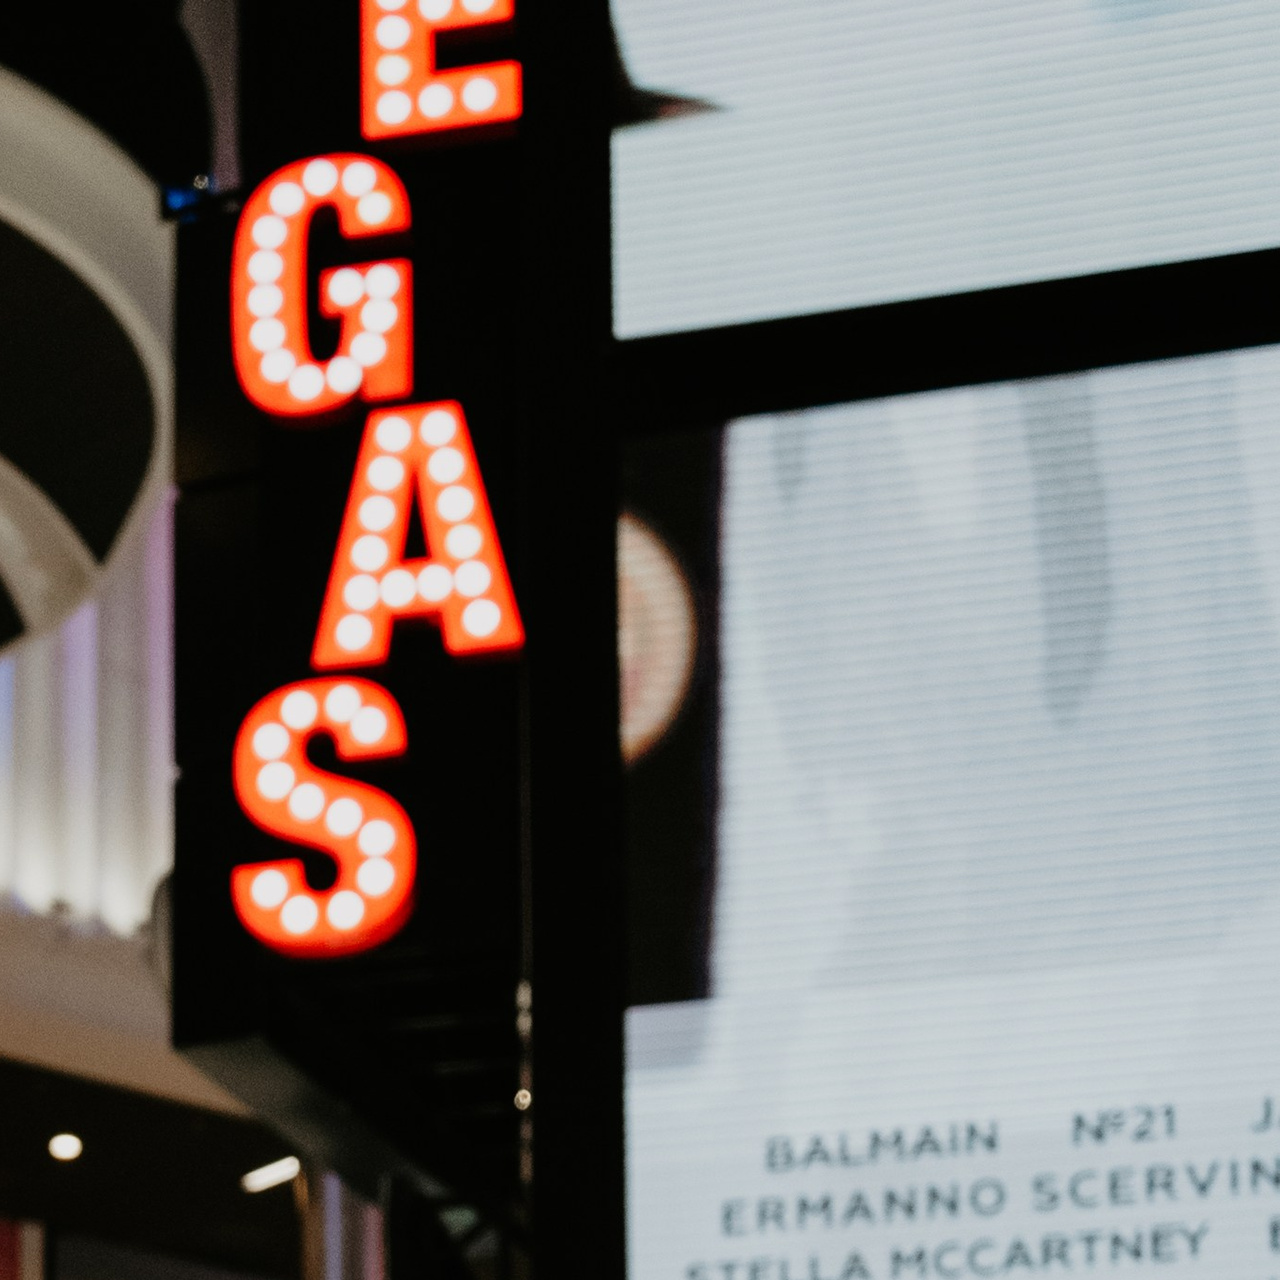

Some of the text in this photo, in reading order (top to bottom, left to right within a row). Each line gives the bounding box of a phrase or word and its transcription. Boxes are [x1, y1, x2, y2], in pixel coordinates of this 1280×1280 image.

[765, 1122, 1000, 1174] BALMAIN
[720, 1179, 1007, 1238] ERMANNO
[889, 1223, 1208, 1280] MCCARTNEY
